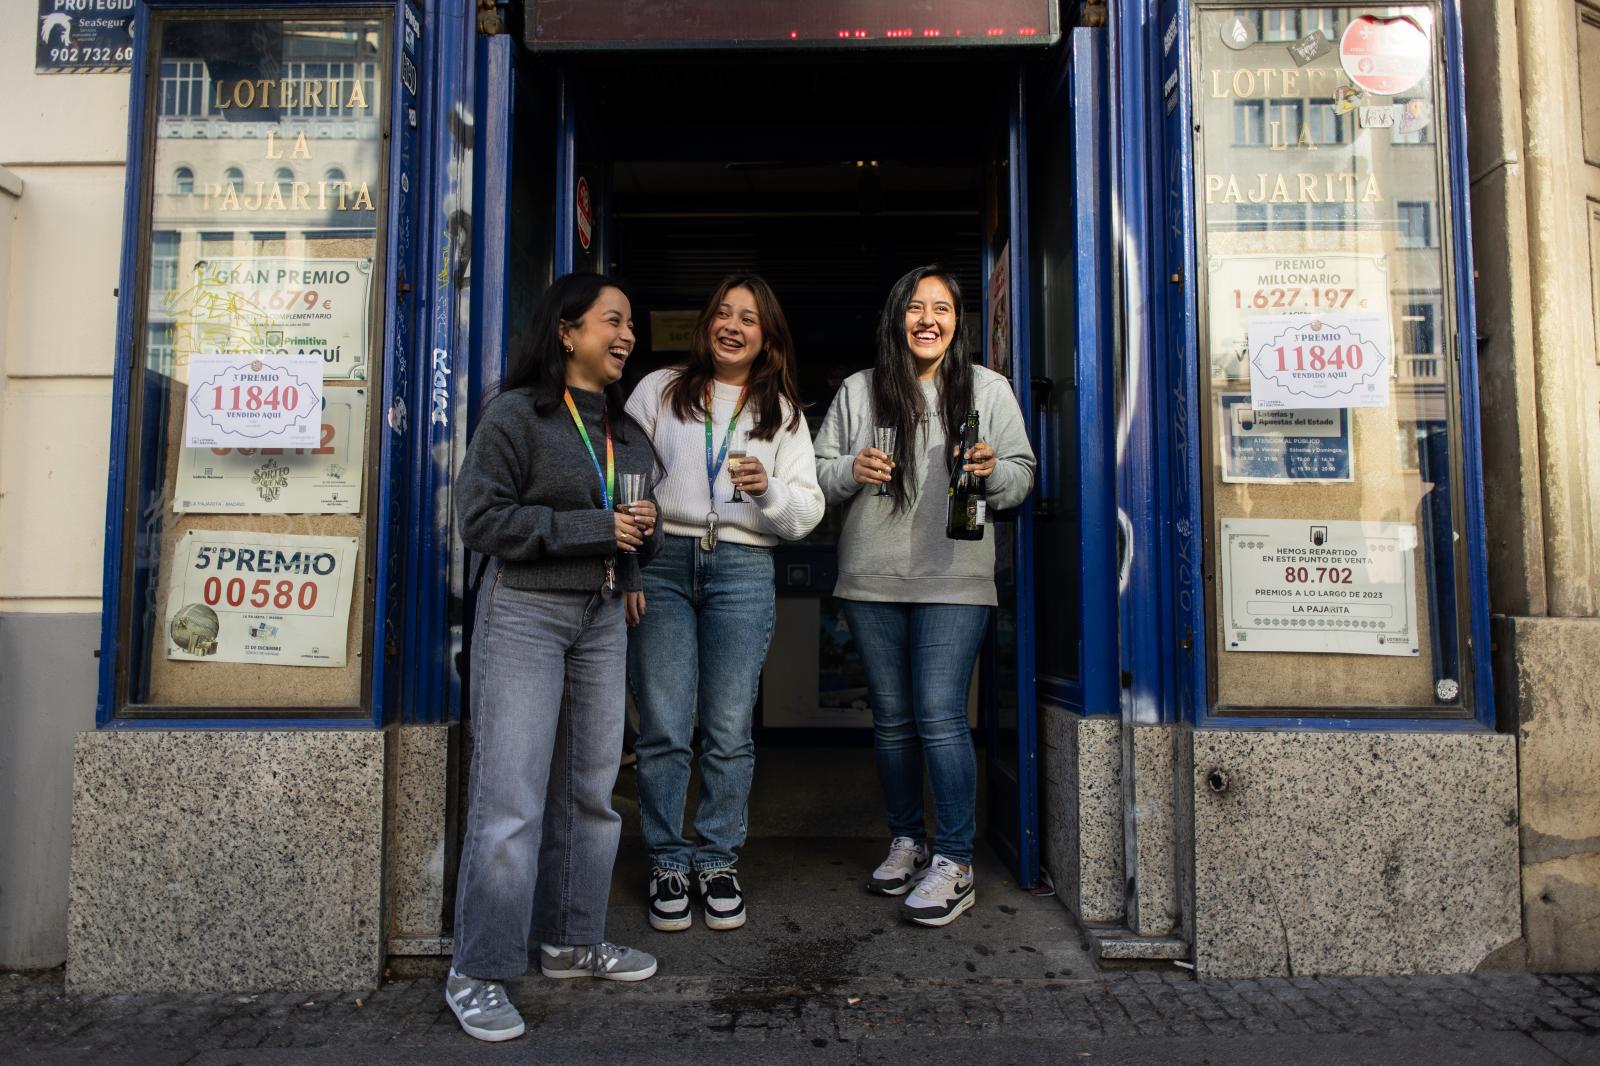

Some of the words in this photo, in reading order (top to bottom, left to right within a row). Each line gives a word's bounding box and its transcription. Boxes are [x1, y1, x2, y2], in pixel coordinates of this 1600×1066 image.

[54, 0, 136, 11] PROTEGID
[50, 48, 79, 61] 902
[83, 48, 111, 61] 732
[215, 79, 368, 109] LOTERIA
[1270, 121, 1318, 151] LA
[265, 129, 313, 160] LA
[1206, 172, 1384, 203] PAJARITA
[203, 181, 376, 211] PAJARITA
[1275, 259, 1326, 270] PREMIO
[216, 270, 270, 284] GRAN
[277, 270, 350, 285] PREMIO
[1257, 273, 1341, 286] MILLONARIO
[322, 299, 332, 310] €
[1233, 287, 1354, 310] 1.627.197
[284, 336, 327, 346] Primitiva
[1301, 333, 1341, 341] PREMIO
[1273, 344, 1363, 372] 11840
[240, 374, 279, 382] PREMIO
[210, 384, 299, 411] 11840
[1294, 418, 1306, 426] del
[1307, 418, 1334, 426] Estado
[217, 547, 336, 576] PREMIO
[1344, 557, 1373, 565] VENTA
[1285, 566, 1353, 584] 80.702
[203, 576, 318, 610] 00580
[1255, 589, 1293, 597] PREMIOS
[1294, 589, 1301, 597] A
[1318, 590, 1347, 598] LARGO
[1362, 591, 1383, 599] 2023
[1292, 605, 1304, 613] LA
[1306, 605, 1350, 614] PAJARITA
